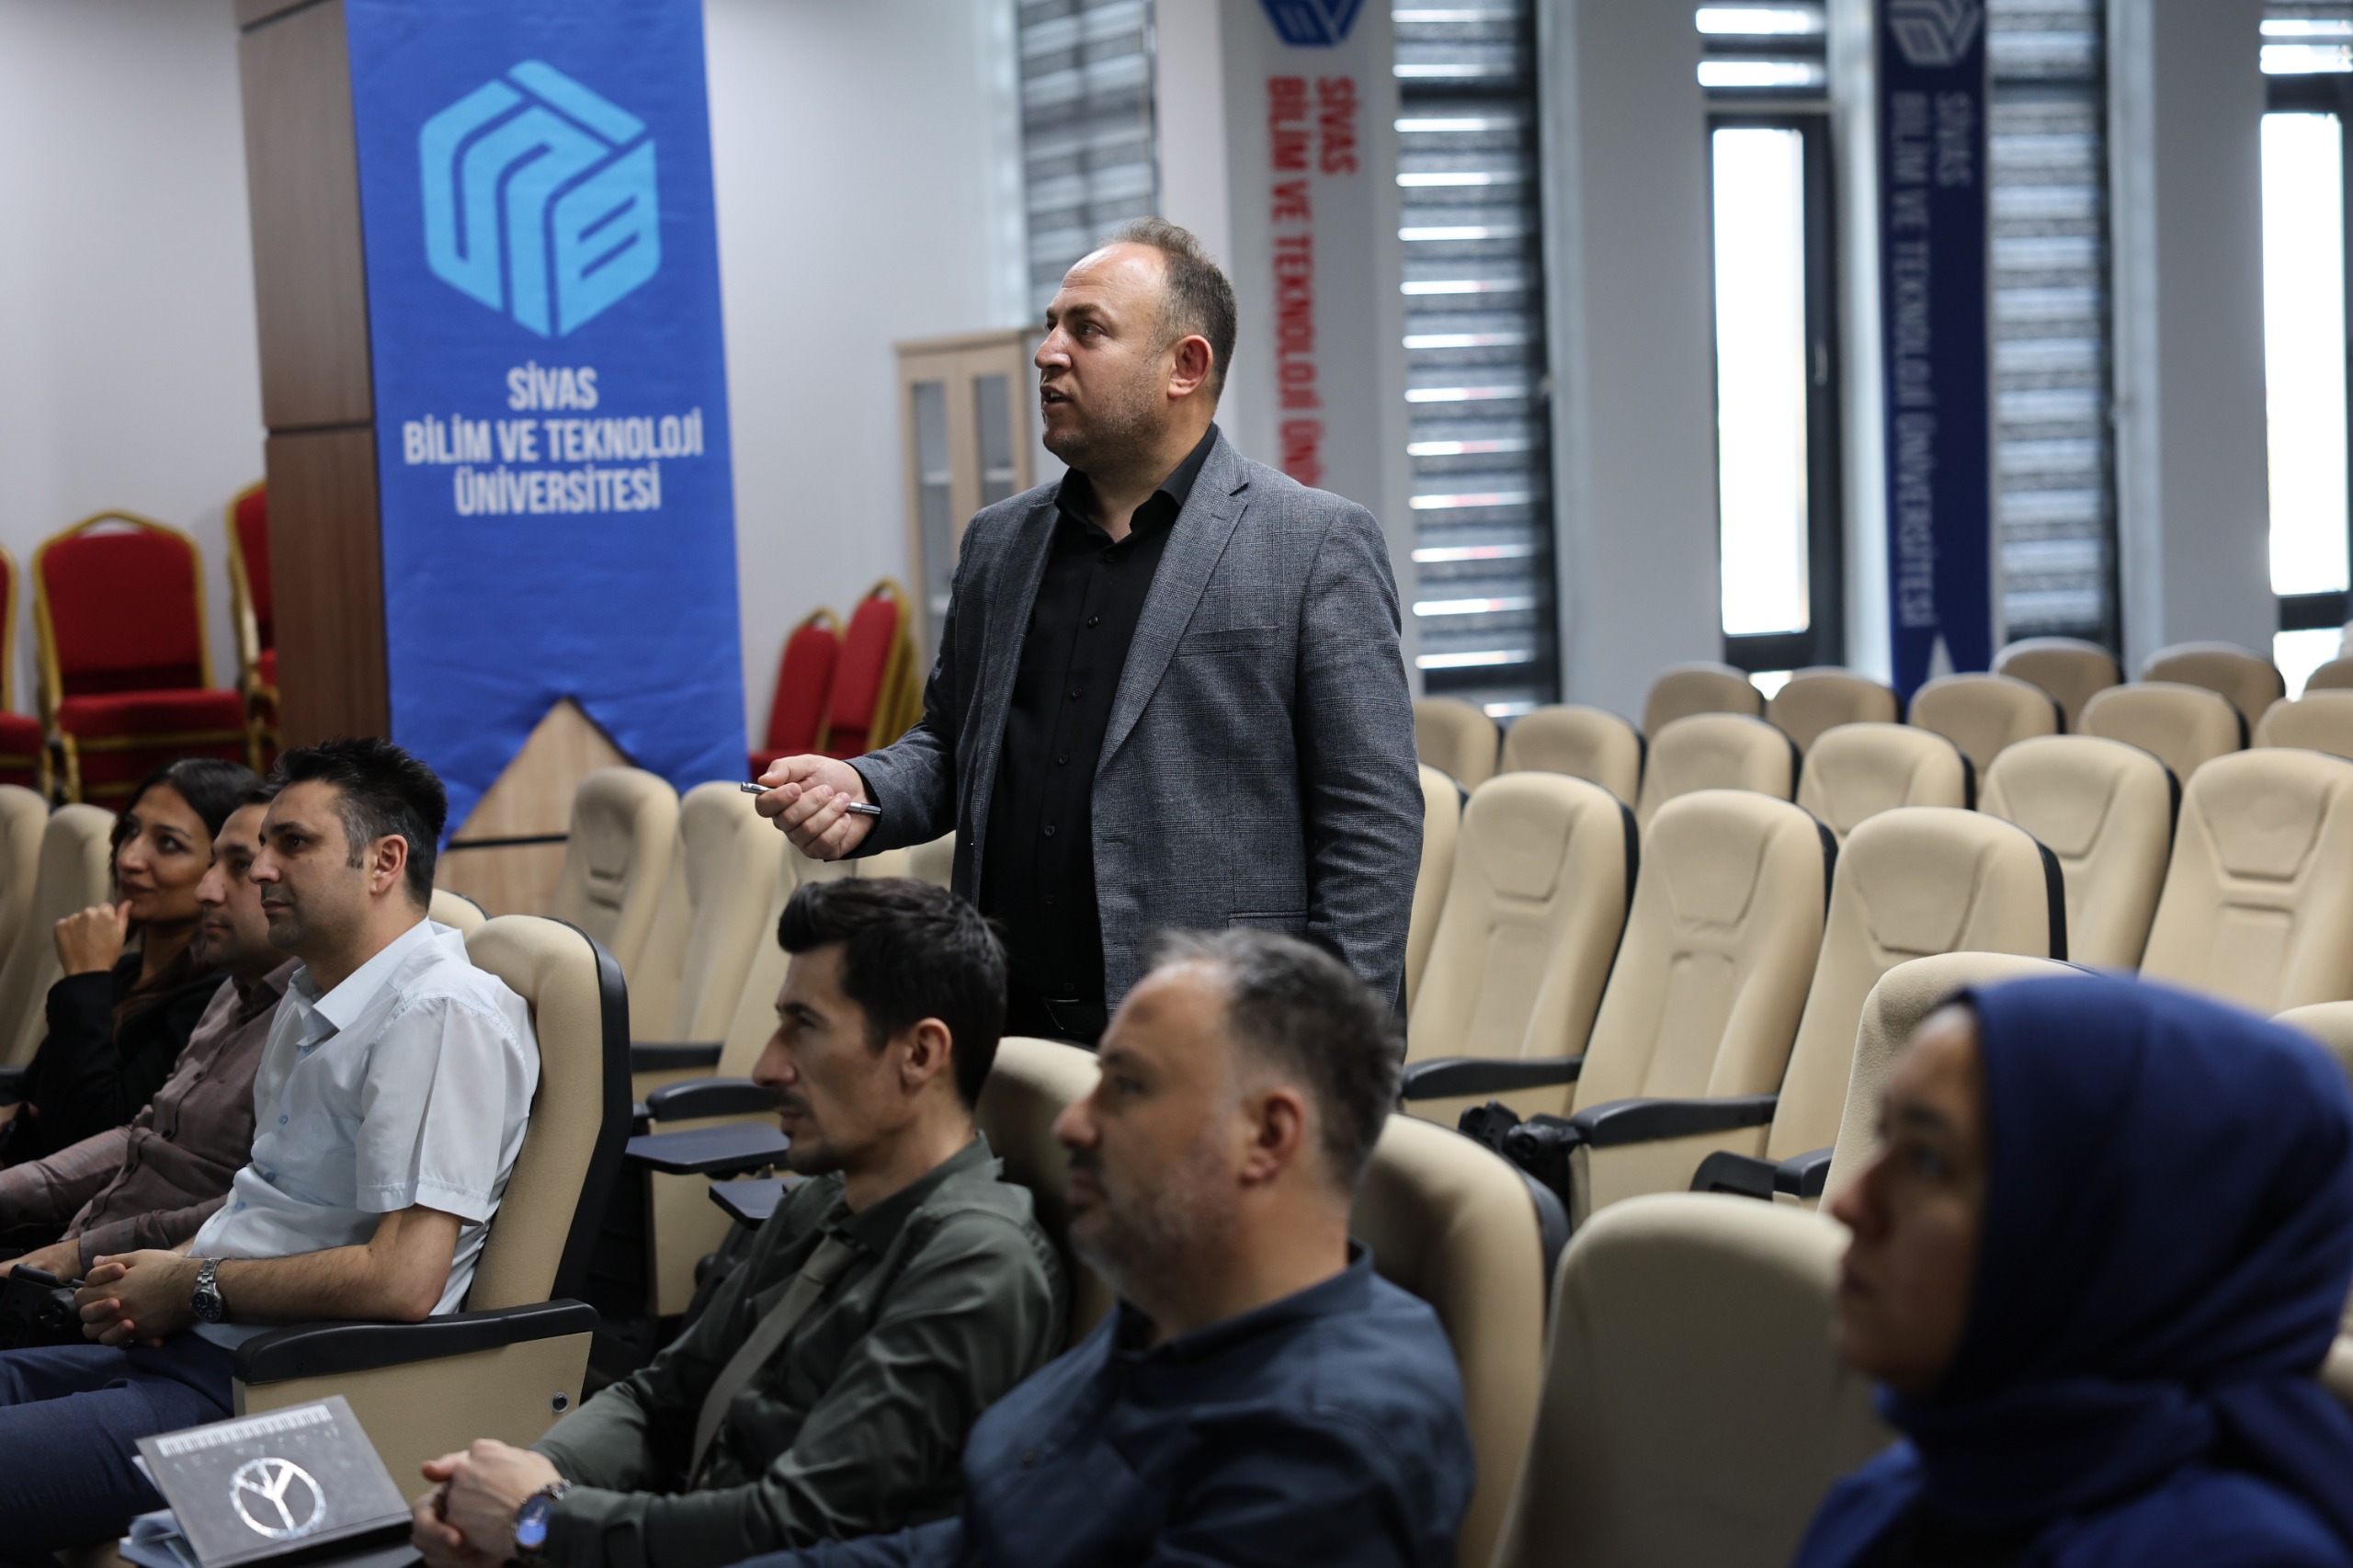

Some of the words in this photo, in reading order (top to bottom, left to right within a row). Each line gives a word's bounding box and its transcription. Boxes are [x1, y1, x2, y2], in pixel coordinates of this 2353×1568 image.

[1267, 75, 1311, 171] BİLİM
[1317, 74, 1360, 175] SİVAS
[1270, 180, 1312, 221] VE
[1272, 233, 1322, 410] TEKNOLOJİ
[506, 359, 598, 411] SİVAS
[403, 413, 492, 464] BİLİM
[496, 417, 540, 462] VE
[543, 406, 704, 461] TEKNOLOJİ
[454, 460, 662, 516] ÜNİVERSİTESİ
